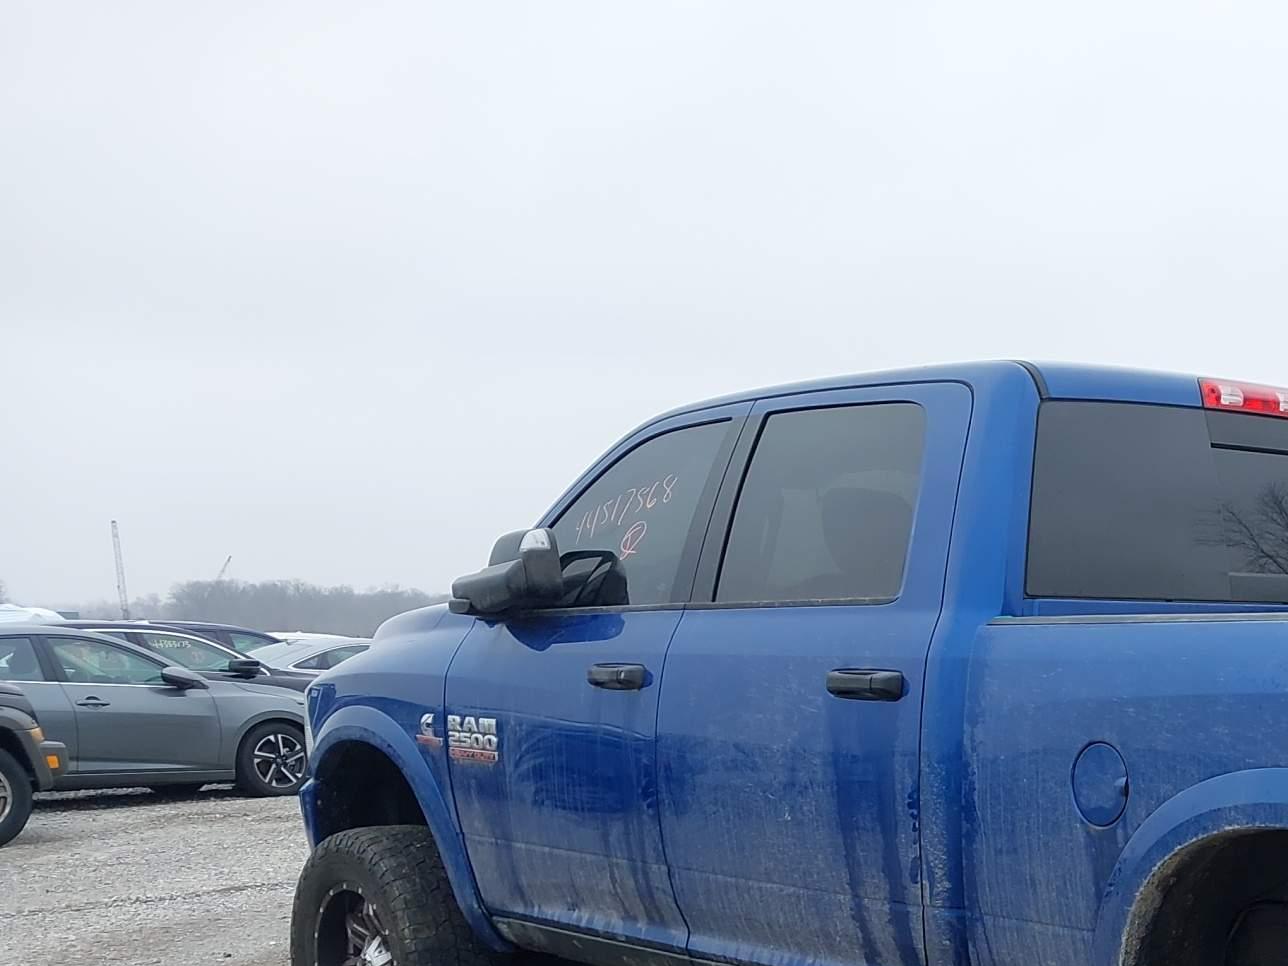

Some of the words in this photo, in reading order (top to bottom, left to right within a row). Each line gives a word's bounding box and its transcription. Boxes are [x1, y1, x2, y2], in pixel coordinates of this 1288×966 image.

[575, 473, 679, 545] 44517568
[447, 714, 498, 735] RAM
[447, 731, 499, 751] 2500
